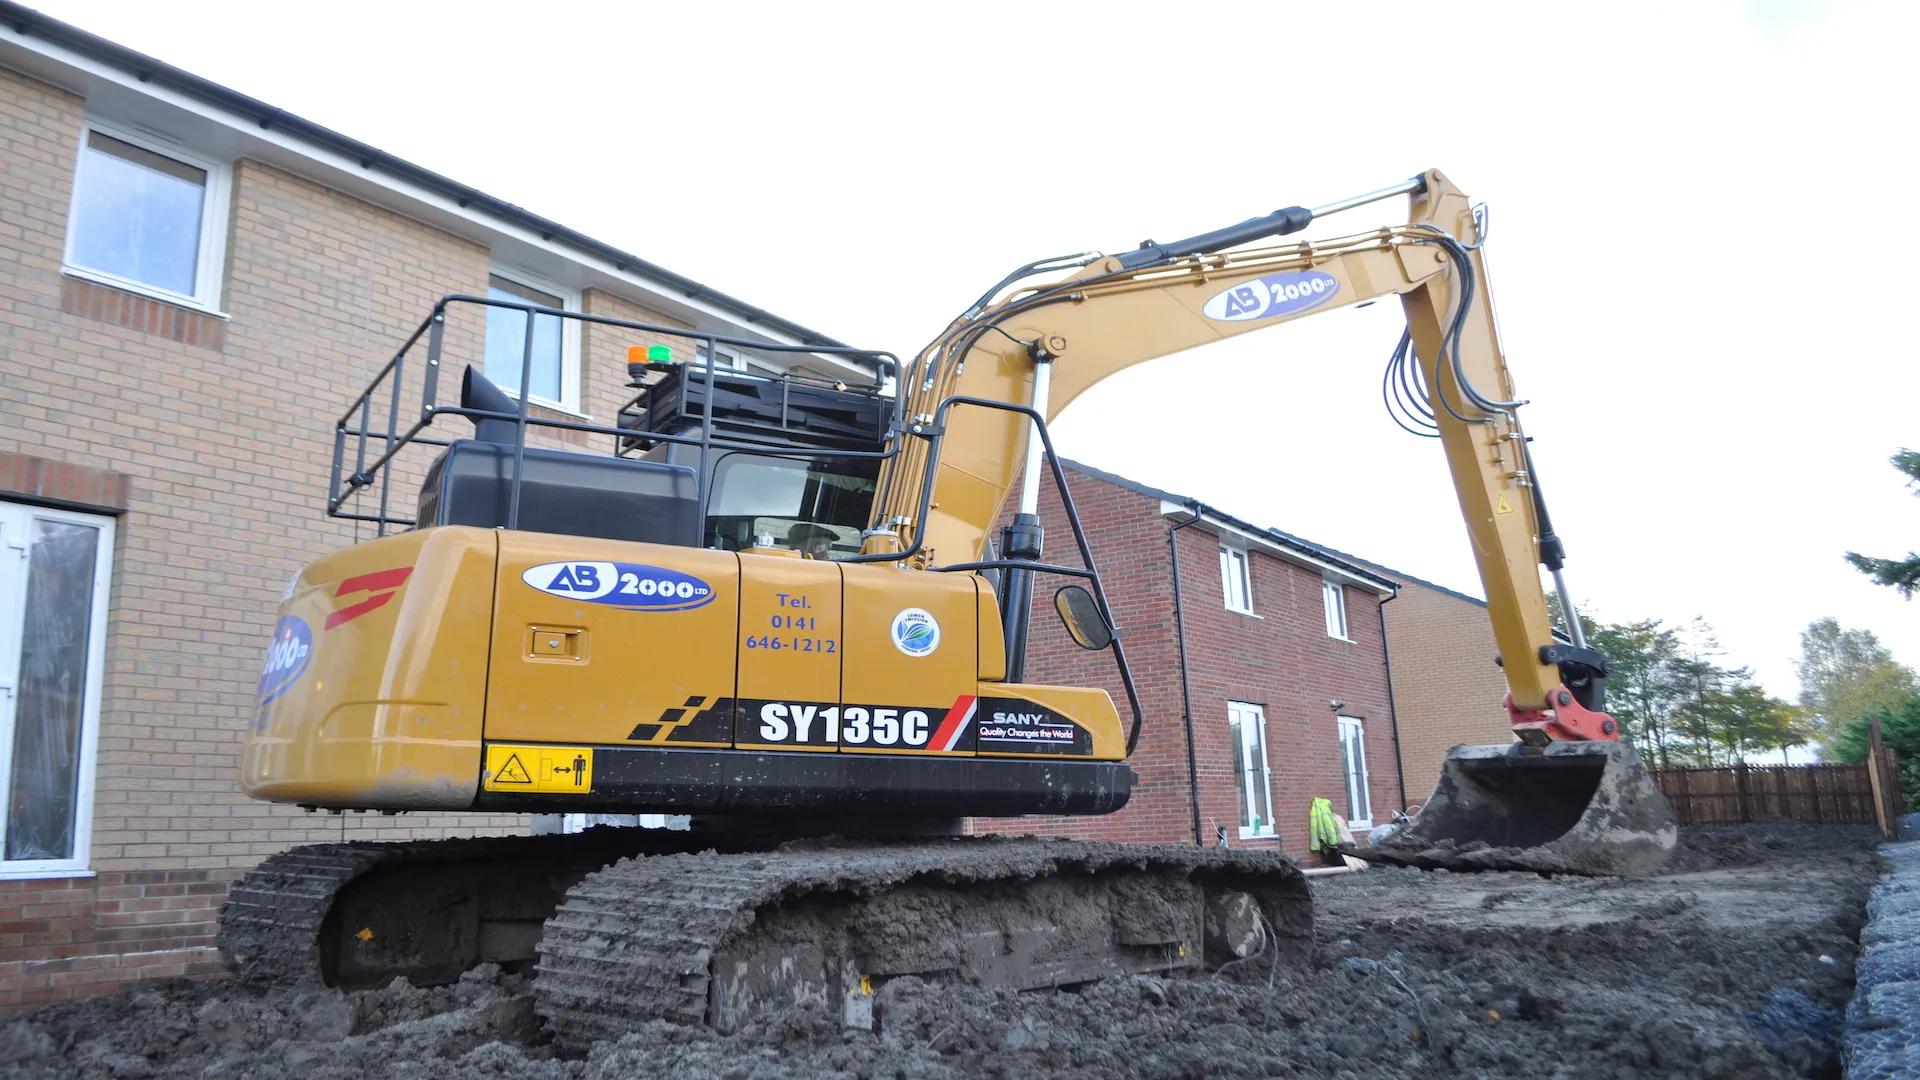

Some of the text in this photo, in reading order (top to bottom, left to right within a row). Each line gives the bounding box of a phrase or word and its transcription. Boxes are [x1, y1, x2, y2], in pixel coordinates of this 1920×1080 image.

[1225, 286, 1261, 318] AB
[1270, 277, 1325, 303] 2000
[546, 564, 708, 599] AB 2000 LTD
[776, 593, 811, 608] Tel.
[771, 615, 815, 630] 0141
[746, 635, 836, 653] 646-1212
[759, 703, 929, 746] SY135C
[993, 712, 1043, 725] SANY
[979, 727, 1073, 739] Quality Changes the World
